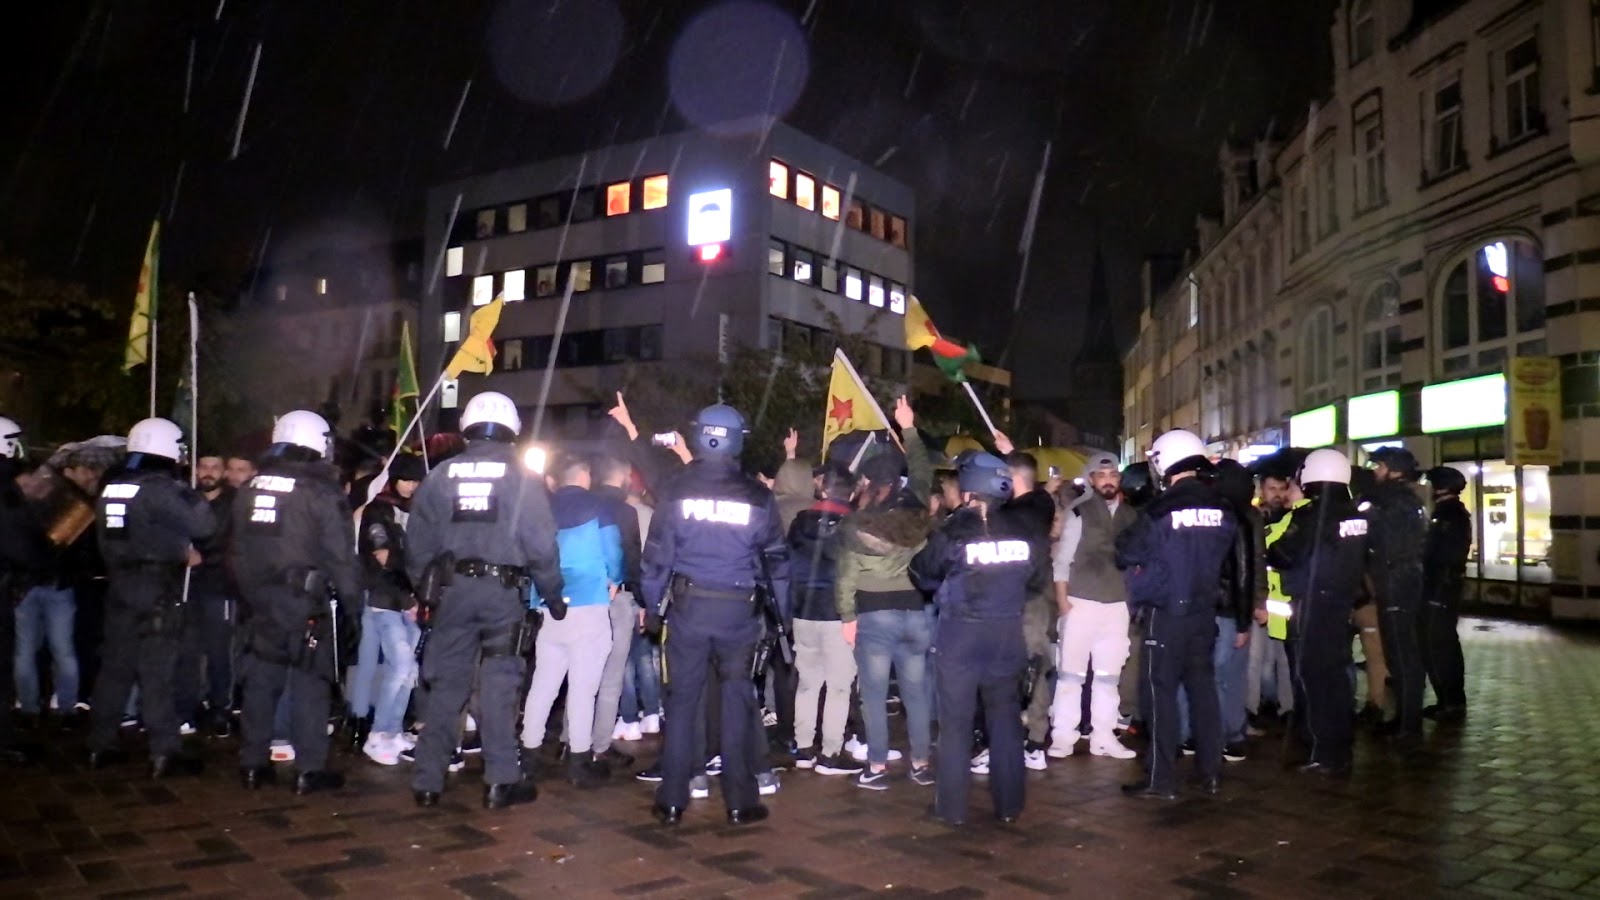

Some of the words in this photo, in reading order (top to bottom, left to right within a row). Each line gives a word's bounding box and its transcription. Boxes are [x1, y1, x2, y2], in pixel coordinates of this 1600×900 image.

[682, 499, 750, 525] POLIZEI
[1171, 509, 1223, 529] POLIZEI
[966, 540, 1029, 564] POLIZEI
